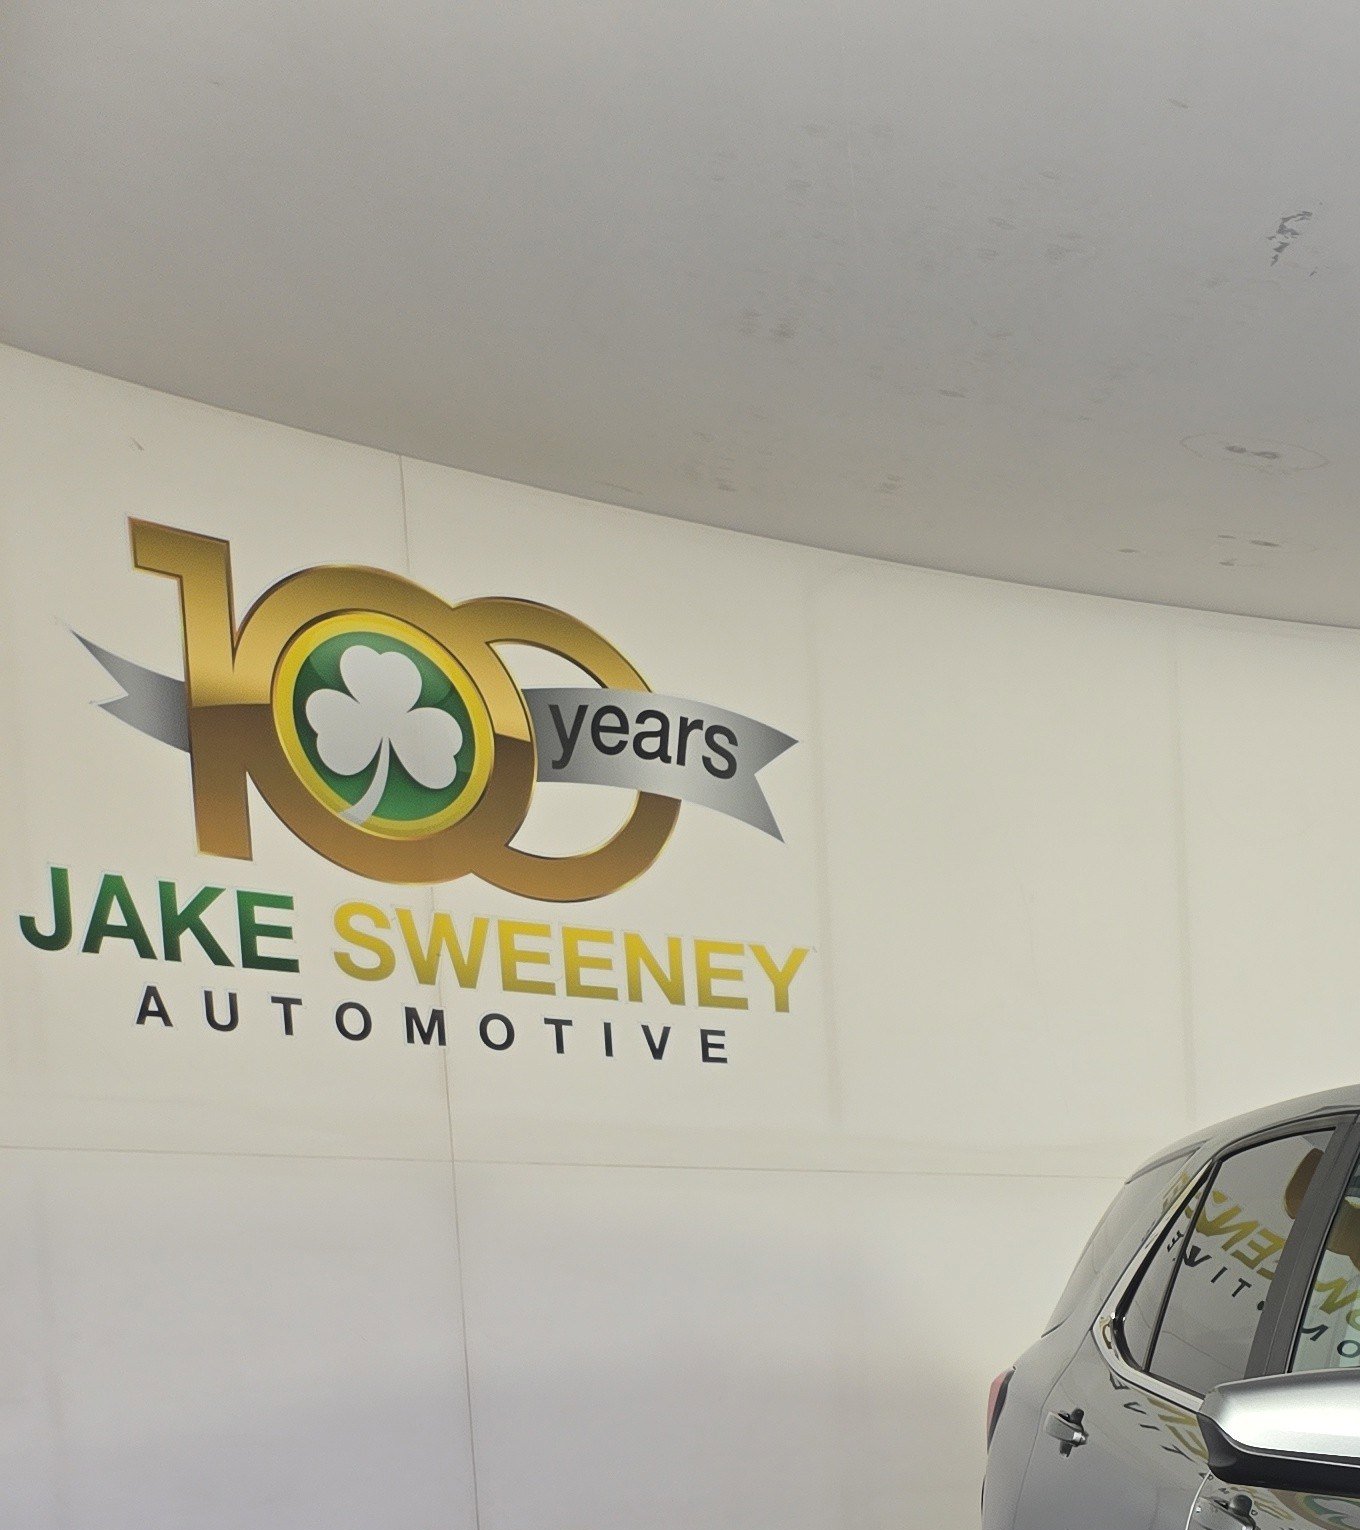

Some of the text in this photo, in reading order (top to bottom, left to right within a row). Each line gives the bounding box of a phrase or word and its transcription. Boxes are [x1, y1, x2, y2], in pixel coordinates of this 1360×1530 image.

[548, 703, 739, 779] years
[19, 866, 809, 1014] JAKE SWEENEY
[136, 985, 729, 1064] AUTOMOTIVE
